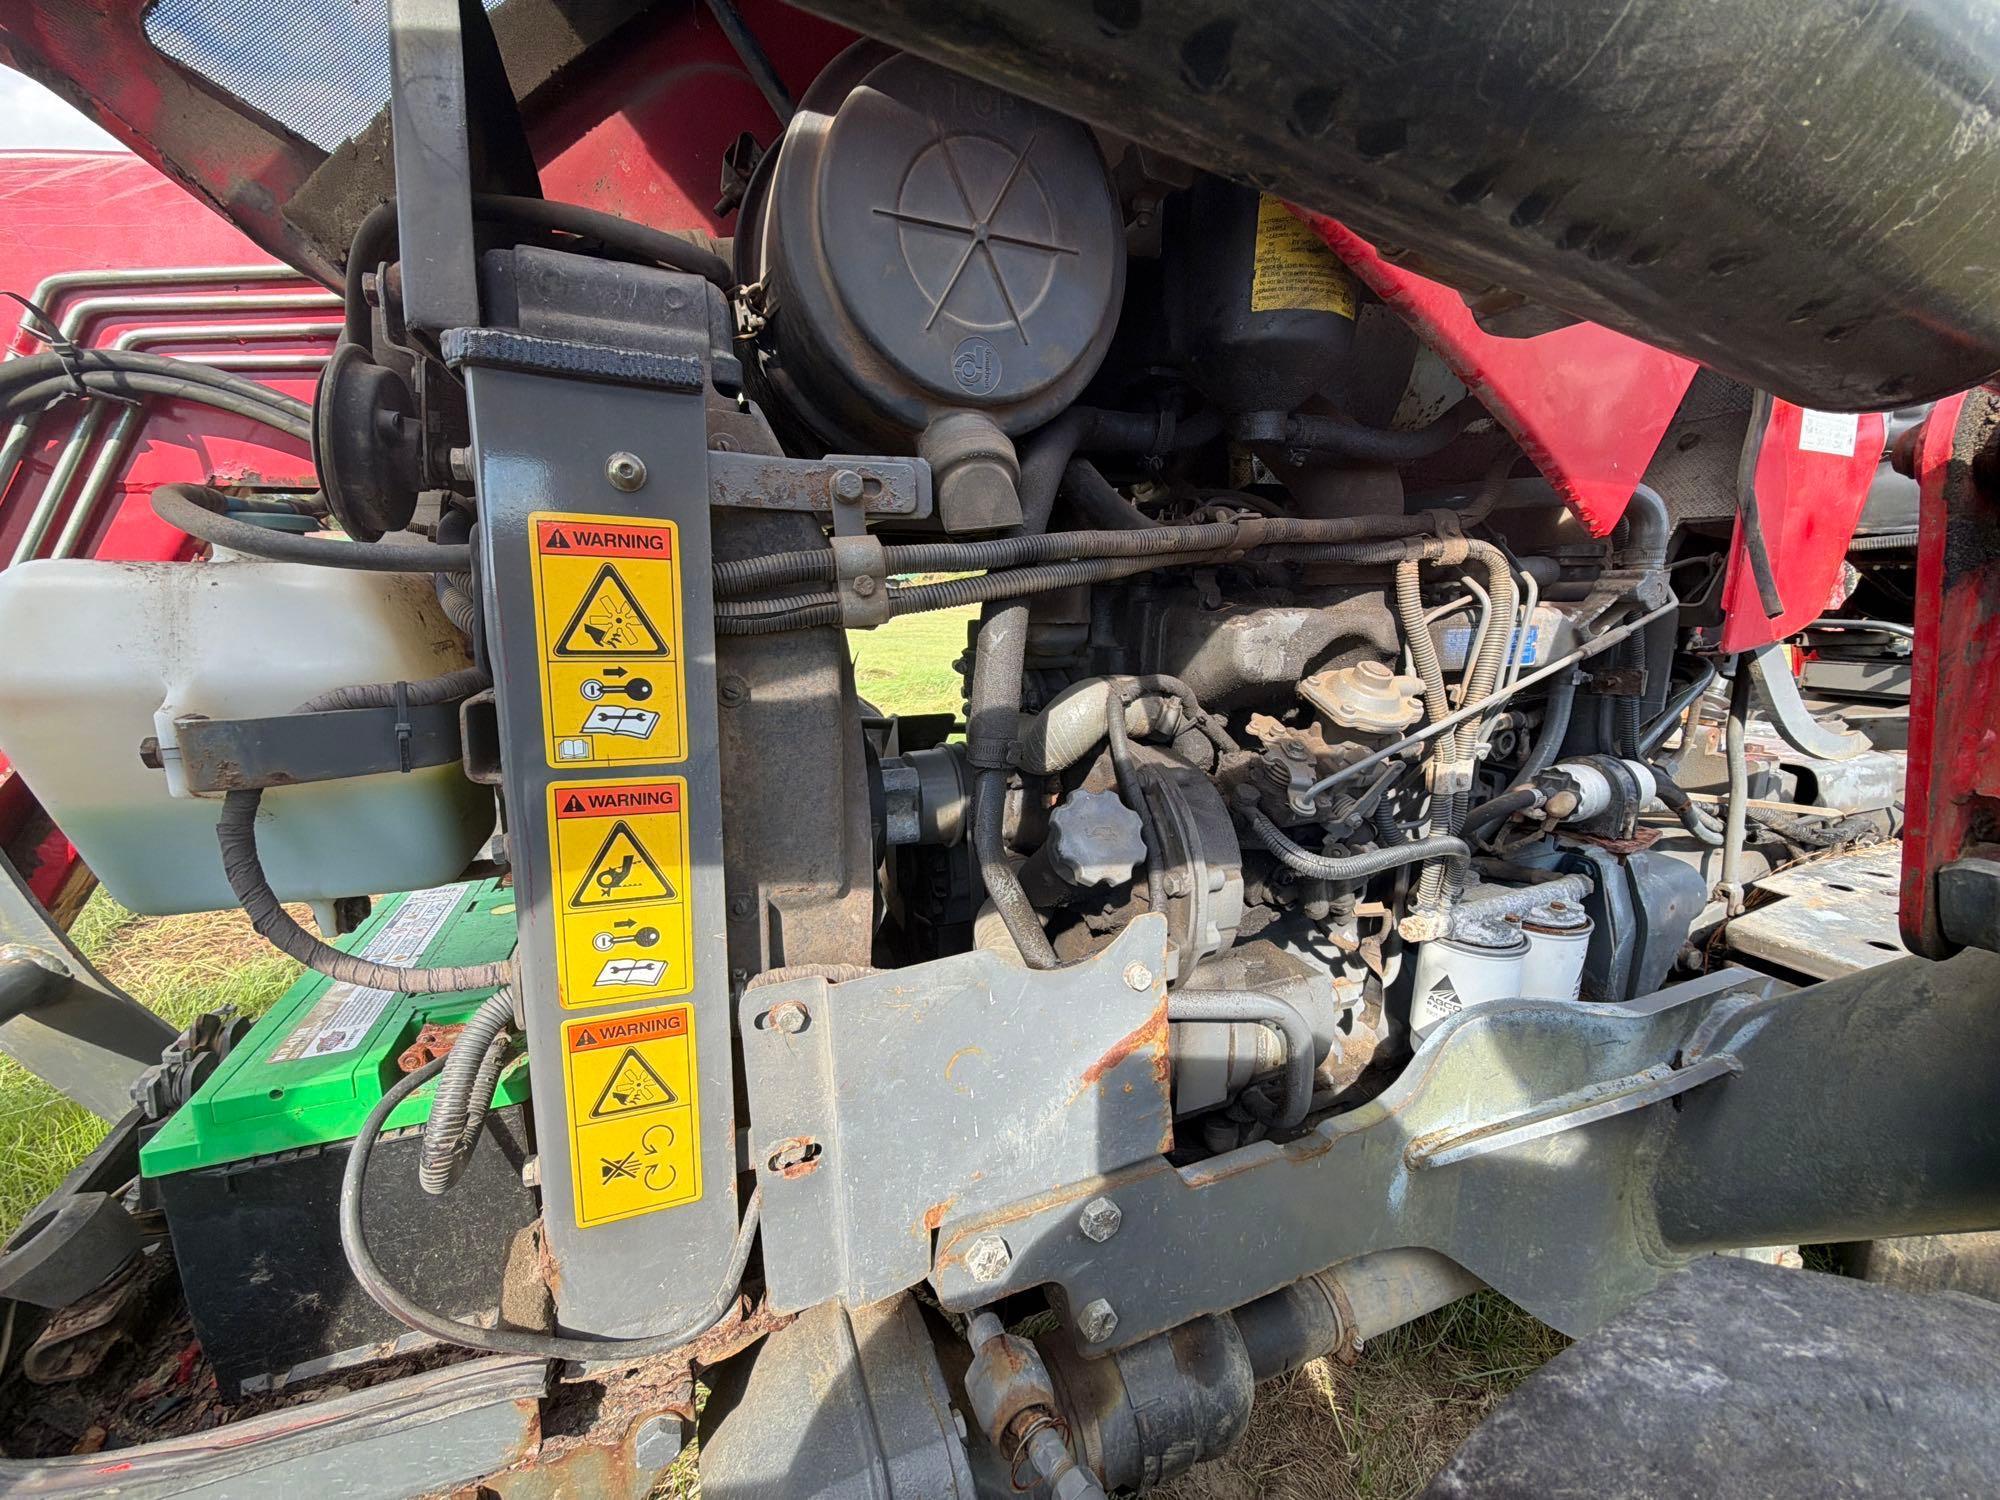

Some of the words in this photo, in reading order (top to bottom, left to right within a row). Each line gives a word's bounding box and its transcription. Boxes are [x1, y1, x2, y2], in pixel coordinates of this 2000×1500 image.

[573, 531, 664, 550] WARNING
[588, 791, 673, 808] WARNING
[1427, 995, 1463, 1013] AGCO
[600, 1016, 680, 1040] WARNING
